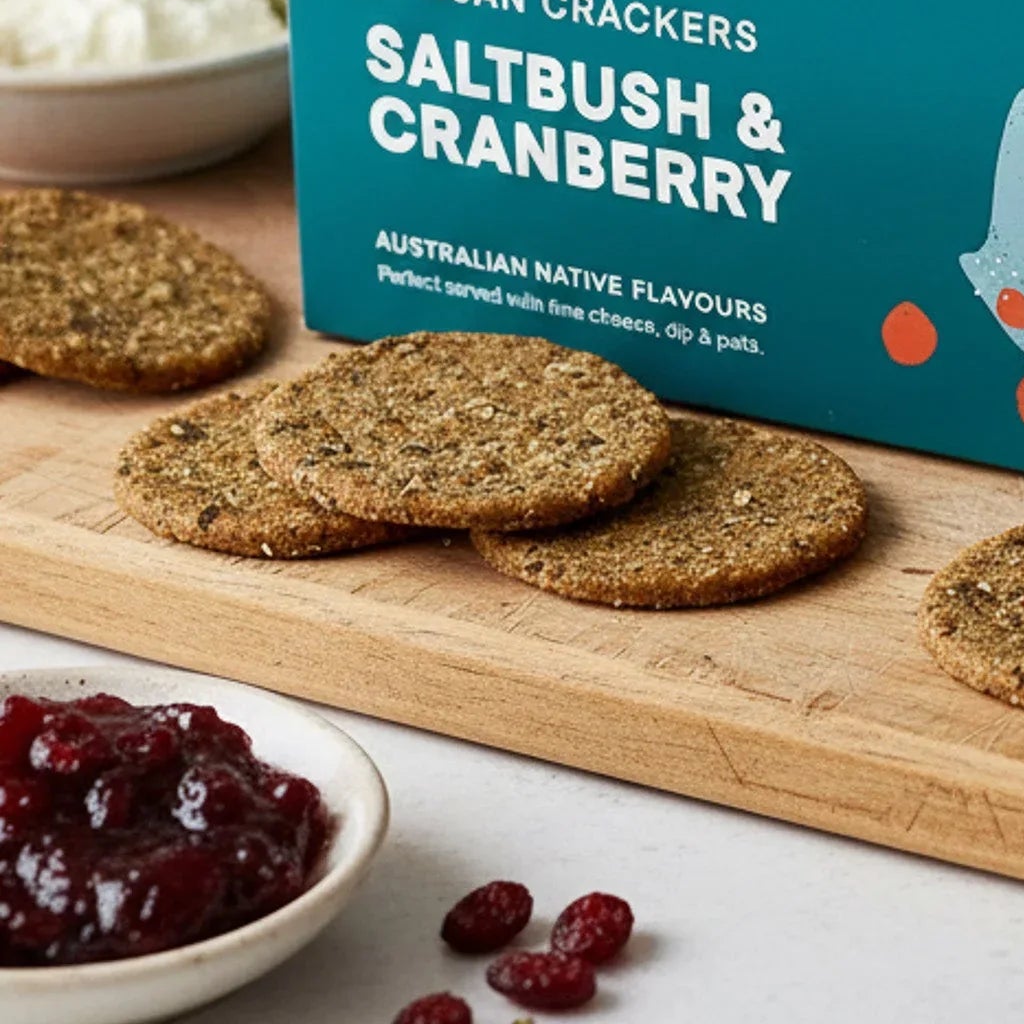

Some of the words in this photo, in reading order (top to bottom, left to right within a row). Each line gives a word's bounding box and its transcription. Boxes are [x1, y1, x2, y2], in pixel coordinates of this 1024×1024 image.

[365, 23, 711, 140] SALTBUSH
[736, 92, 786, 154] &
[368, 95, 792, 224] CRANBERRY
[375, 230, 527, 278] AUSTRALIAN
[535, 261, 623, 297] NATIVE
[631, 279, 768, 324] FLAVOURS
[665, 322, 694, 345] dip
